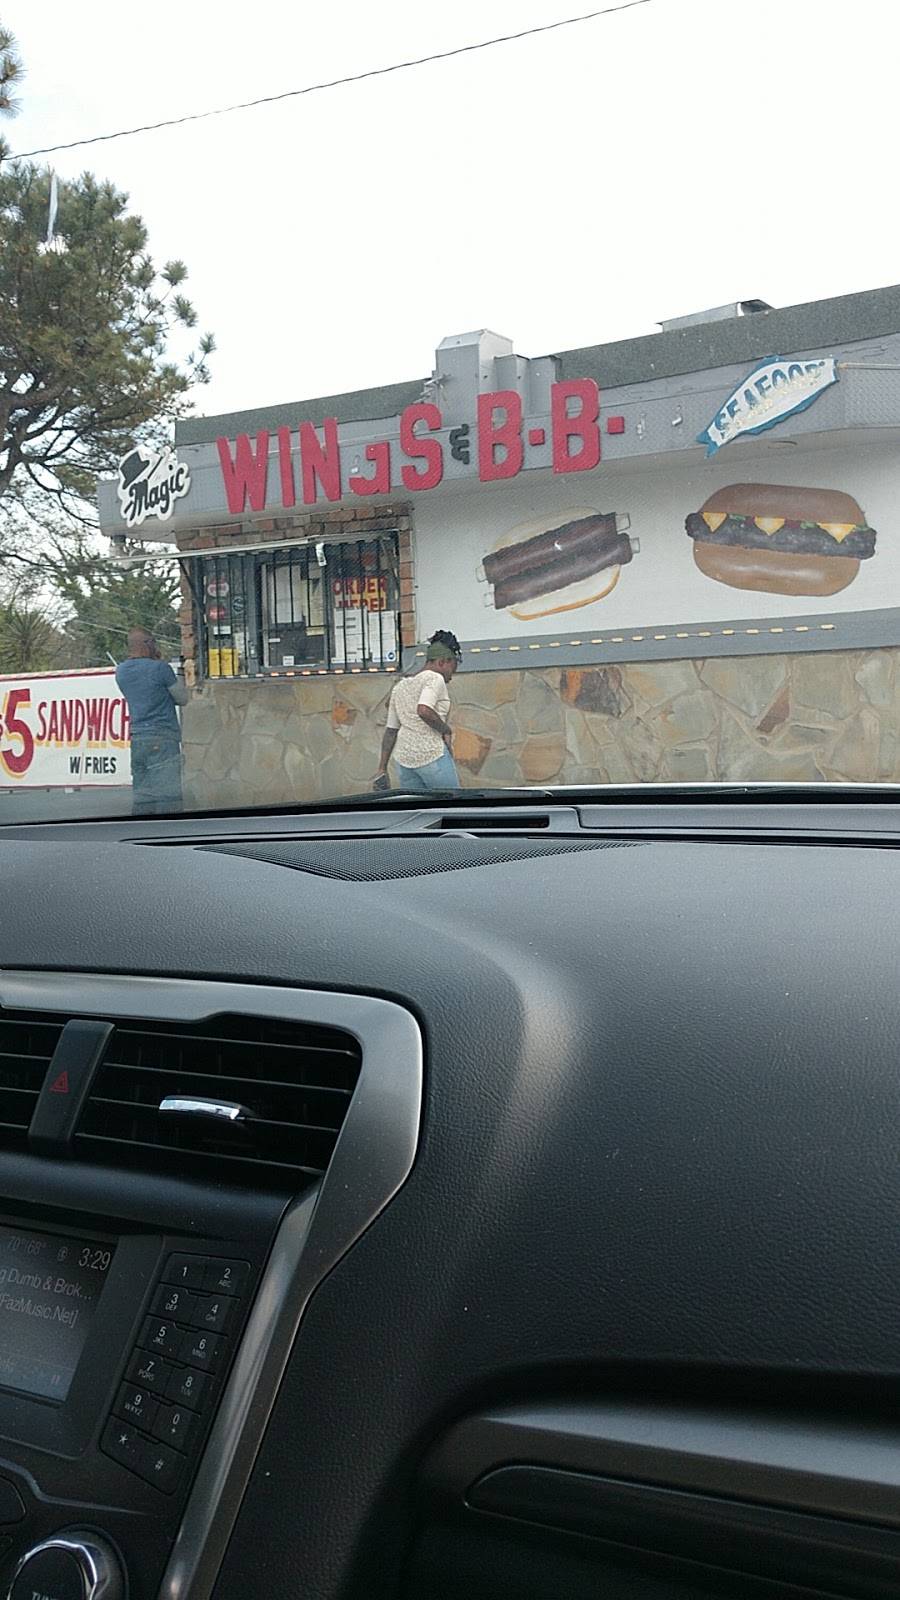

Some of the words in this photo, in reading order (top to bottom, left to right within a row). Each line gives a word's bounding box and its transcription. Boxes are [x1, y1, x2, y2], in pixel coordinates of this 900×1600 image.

[216, 402, 443, 514] WINGS
[124, 464, 185, 521] Magic
[84, 756, 117, 774] FRIES
[78, 1247, 112, 1271] 3:29
[182, 1266, 188, 1277] 1
[223, 1267, 231, 1279] 2
[8, 1268, 41, 1289] Dumb
[43, 1275, 52, 1290] &
[171, 1293, 179, 1305] 3
[211, 1304, 219, 1315] 4
[158, 1326, 166, 1338] 5
[199, 1339, 207, 1350] 6
[146, 1361, 154, 1372] 7
[185, 1376, 193, 1388] 8
[134, 1394, 142, 1406] 9
[172, 1413, 180, 1425] 0
